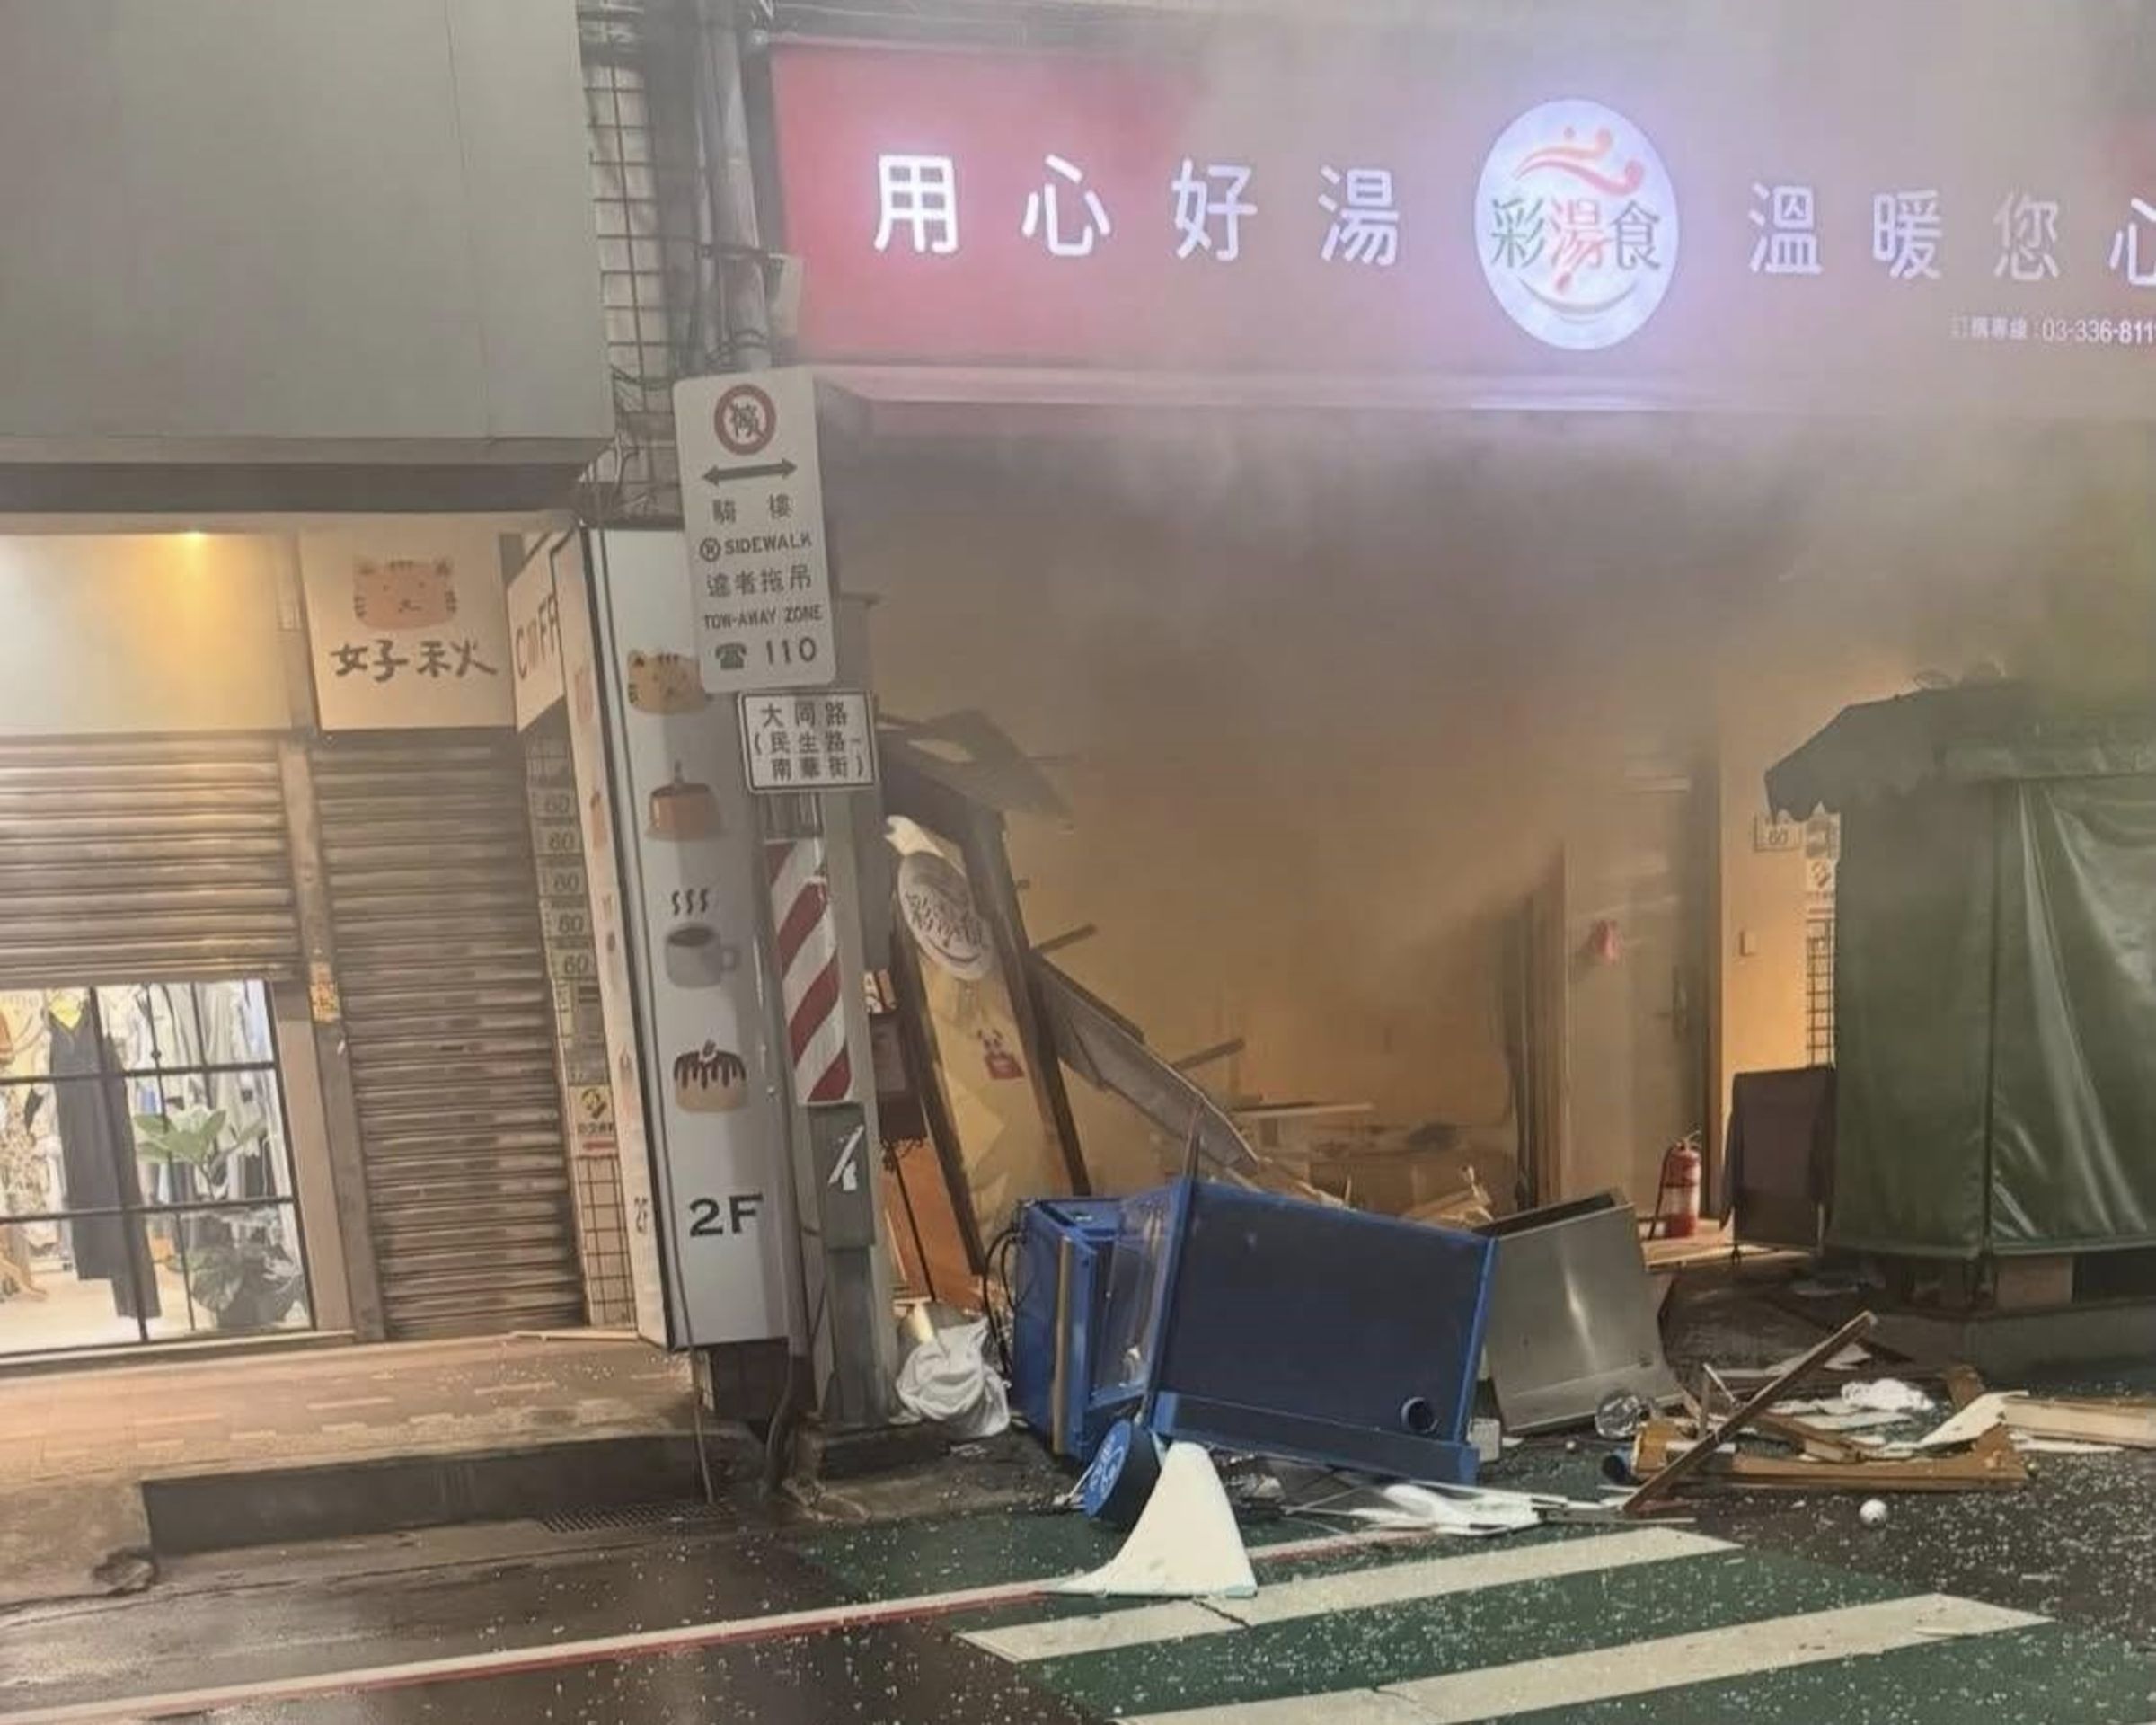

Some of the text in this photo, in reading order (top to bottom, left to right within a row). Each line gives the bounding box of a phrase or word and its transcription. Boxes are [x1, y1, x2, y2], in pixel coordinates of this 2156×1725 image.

[874, 155, 1401, 267] 用心好湯
[1489, 196, 1661, 286] 彩湯食
[2042, 317, 2156, 345] 03-336-811
[724, 532, 812, 555] SIDEWALK
[706, 563, 811, 598] 違者拖吊
[704, 604, 823, 629] TOW-AWAY ZONE
[765, 636, 817, 666] 110
[761, 701, 847, 729] 大同路
[688, 1193, 764, 1238] 2F
